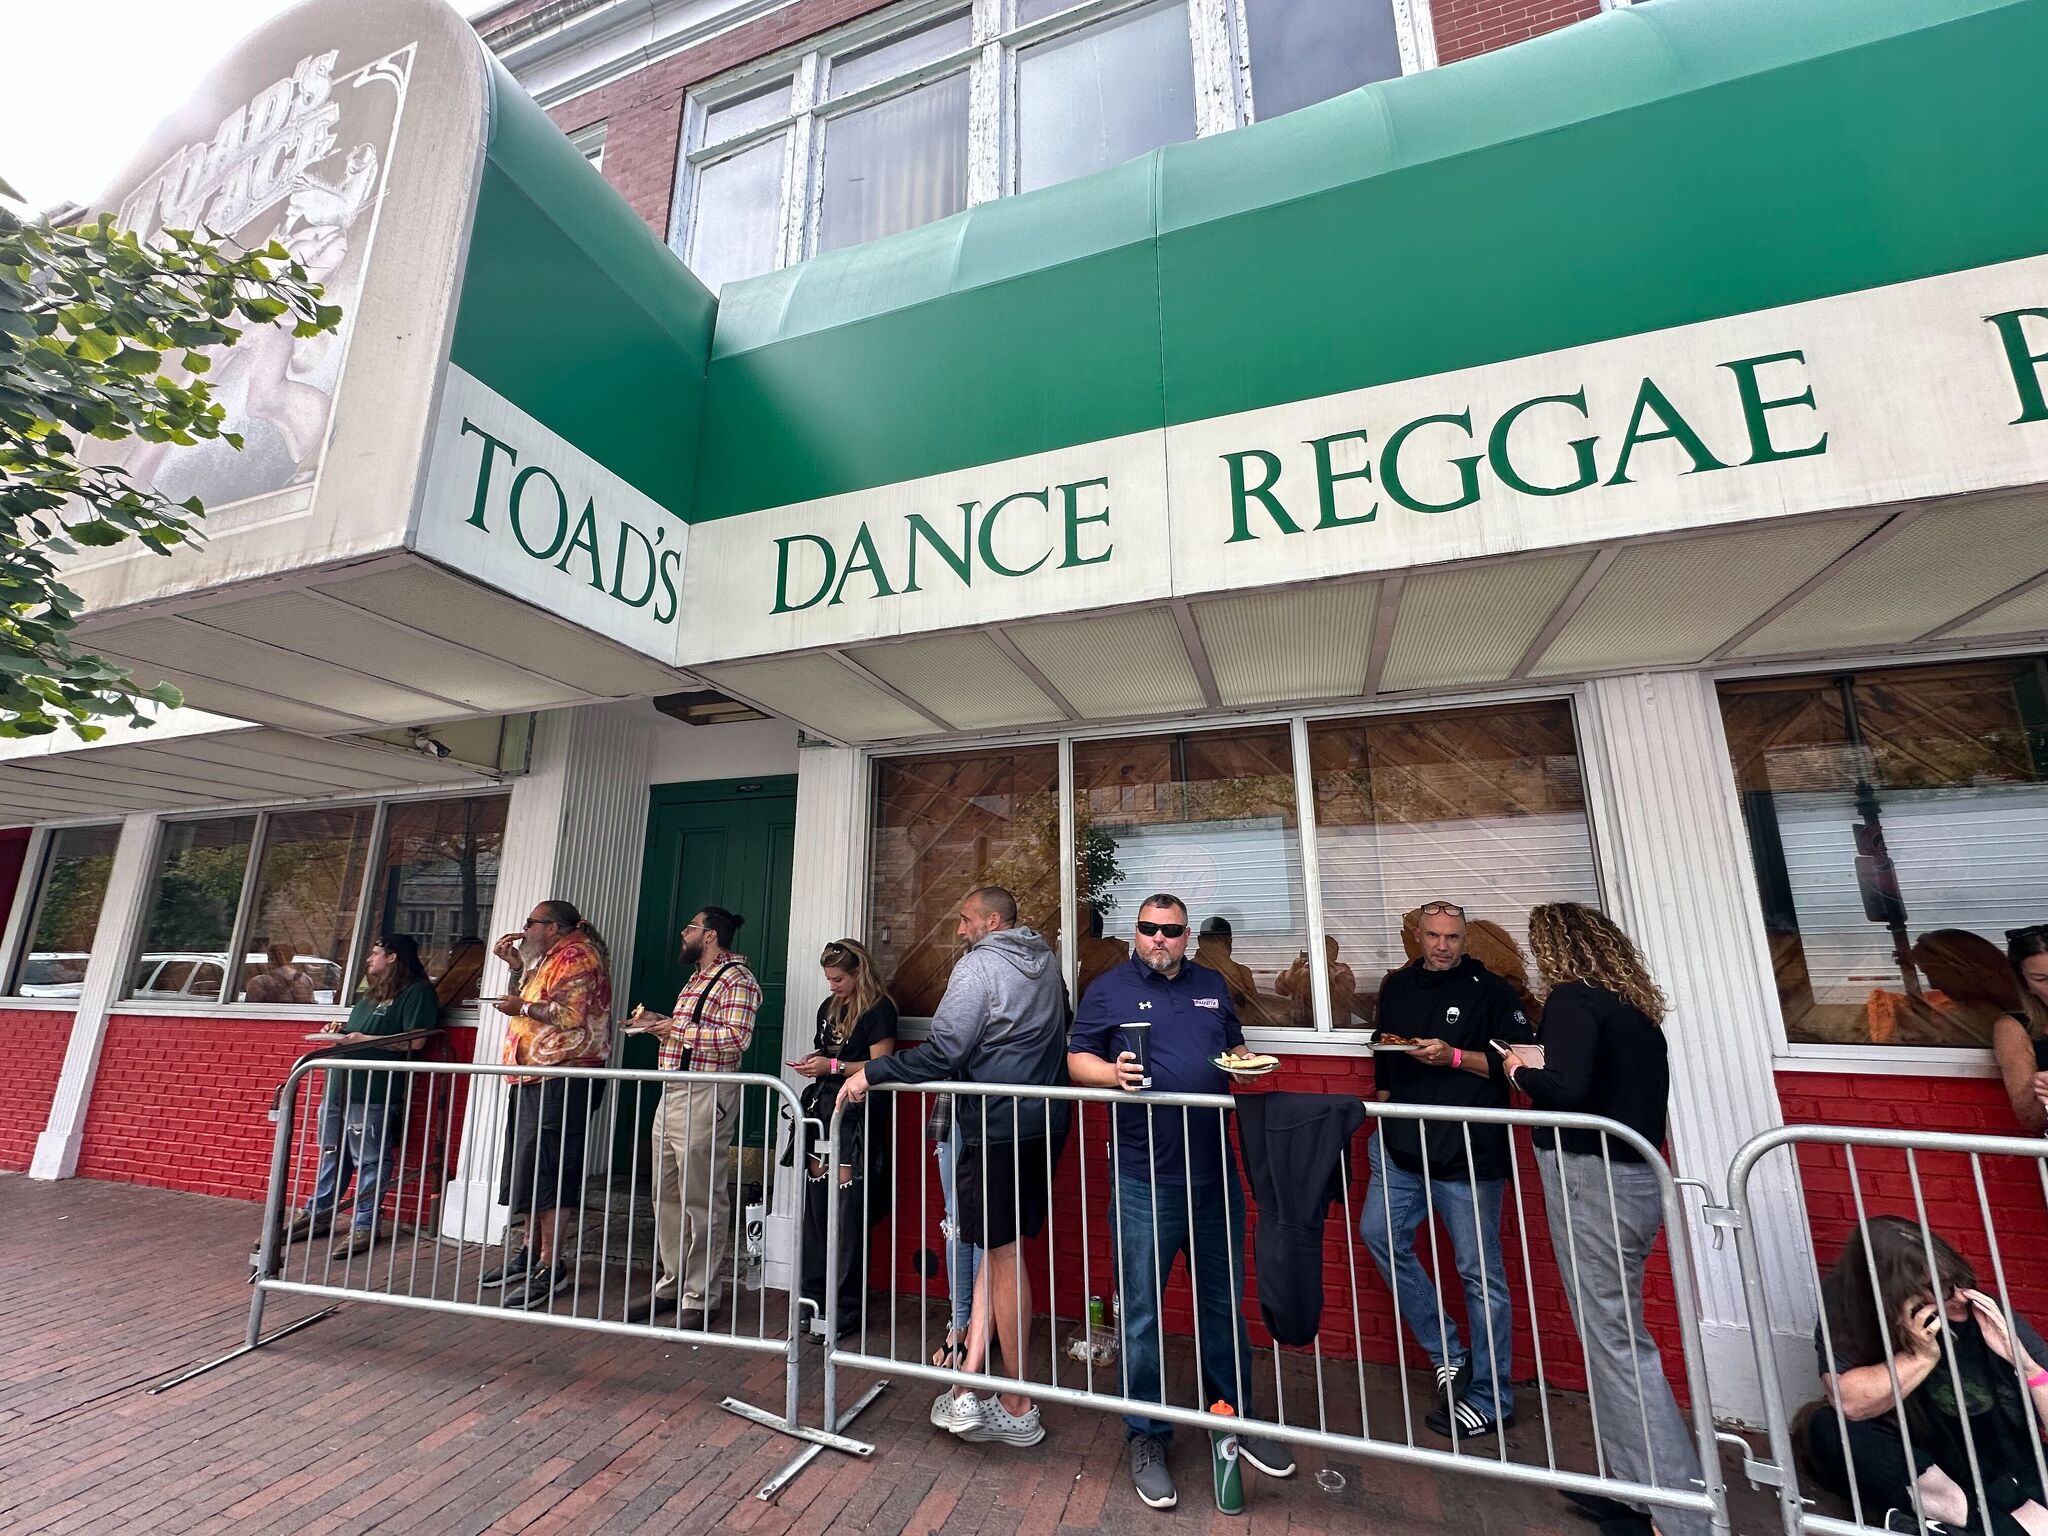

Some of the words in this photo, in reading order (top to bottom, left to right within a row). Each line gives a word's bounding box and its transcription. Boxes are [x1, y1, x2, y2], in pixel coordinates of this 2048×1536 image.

[460, 416, 682, 625] TOAD'S
[769, 477, 1114, 615] DANCE
[1218, 349, 1829, 544] REGGAE
